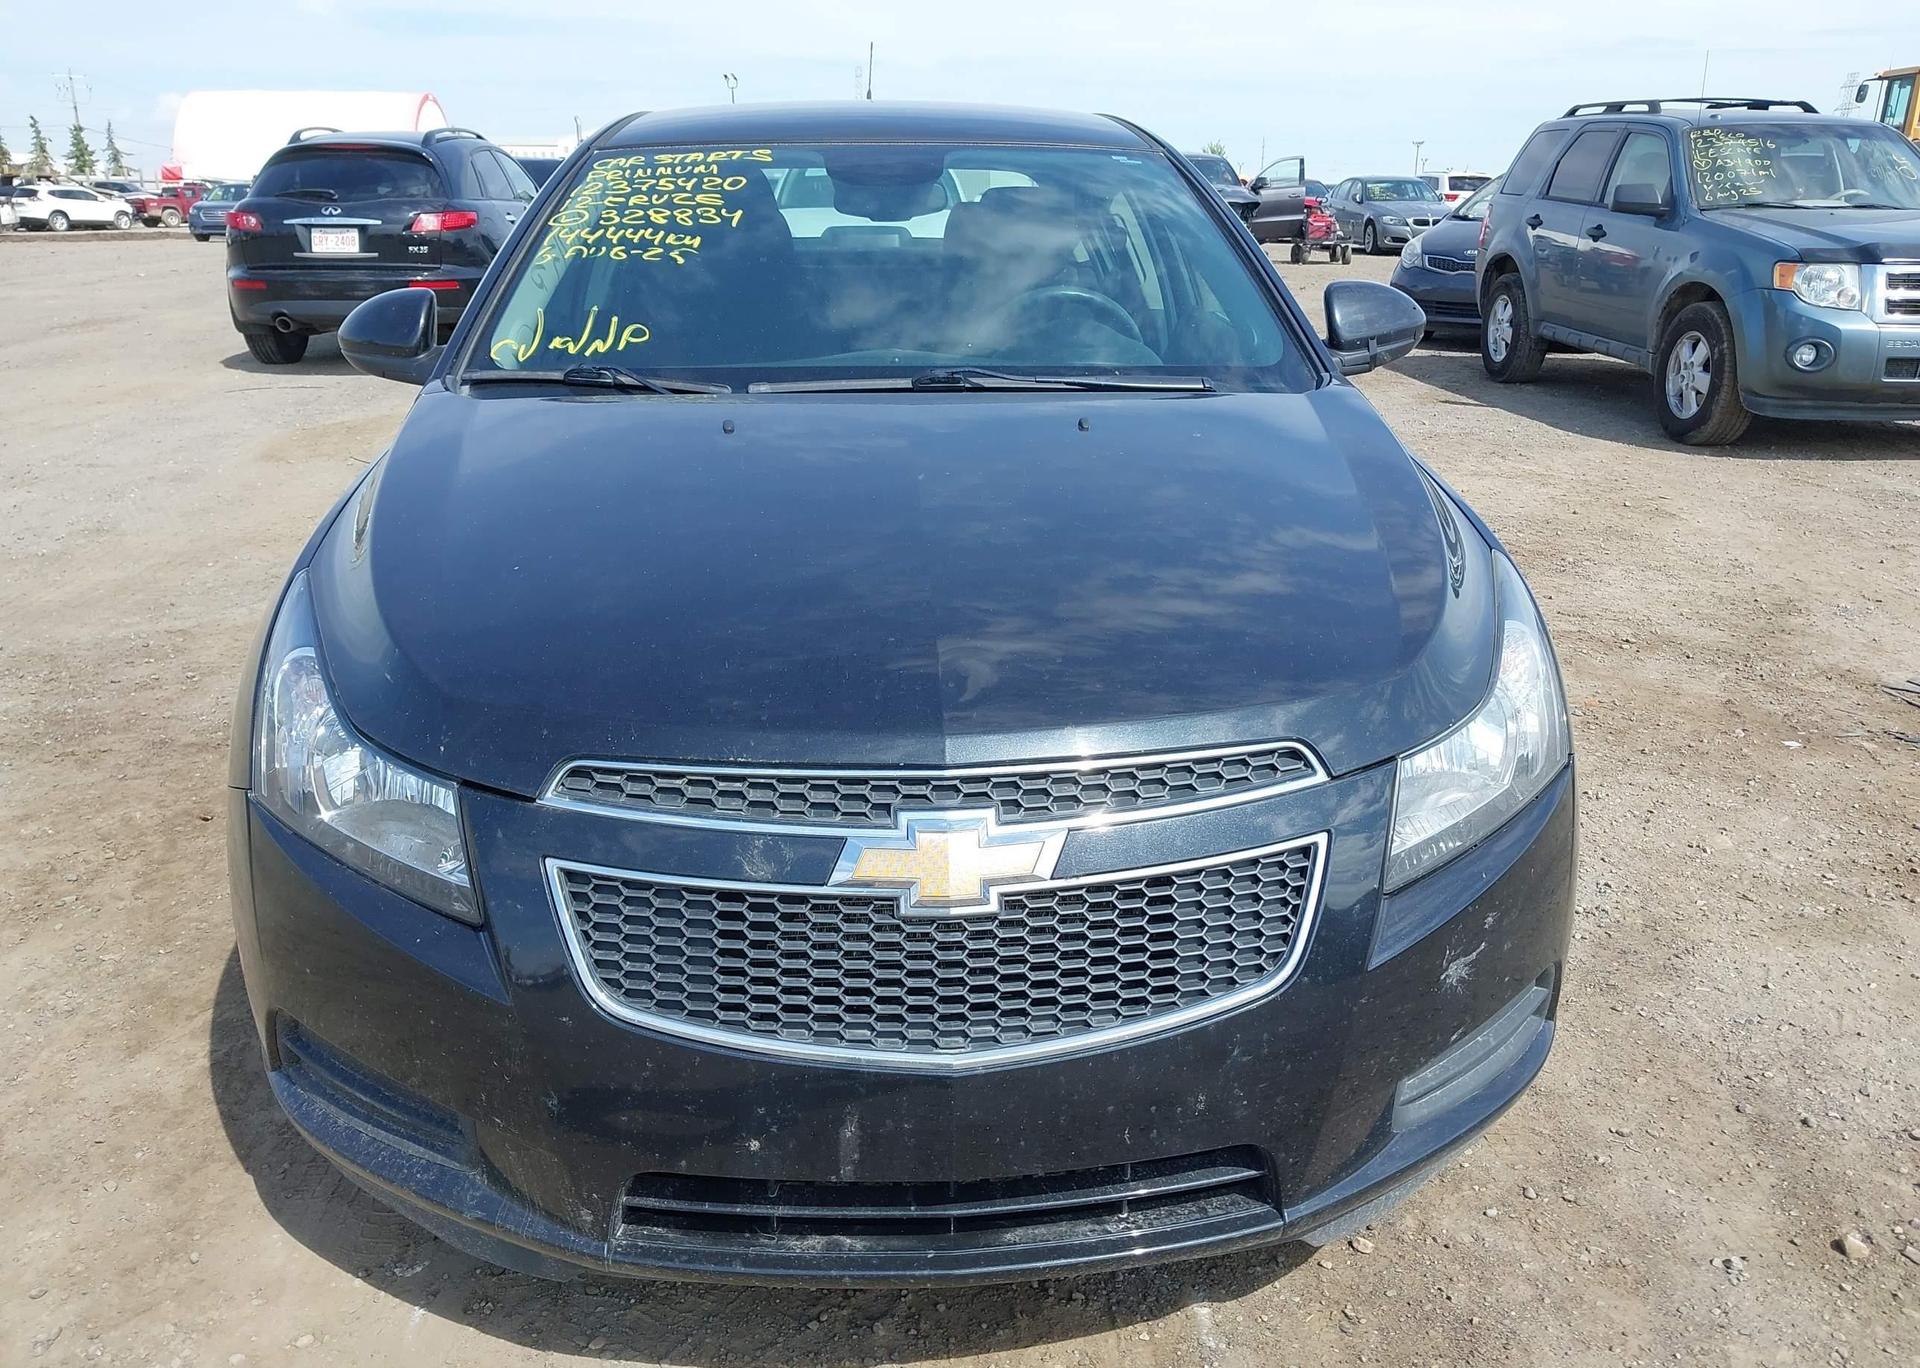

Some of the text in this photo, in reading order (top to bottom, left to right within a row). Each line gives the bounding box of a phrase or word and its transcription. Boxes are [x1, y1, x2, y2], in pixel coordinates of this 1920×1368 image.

[593, 149, 774, 170] CAR STARTS
[570, 176, 747, 197] 12375420
[599, 207, 744, 227] 328834
